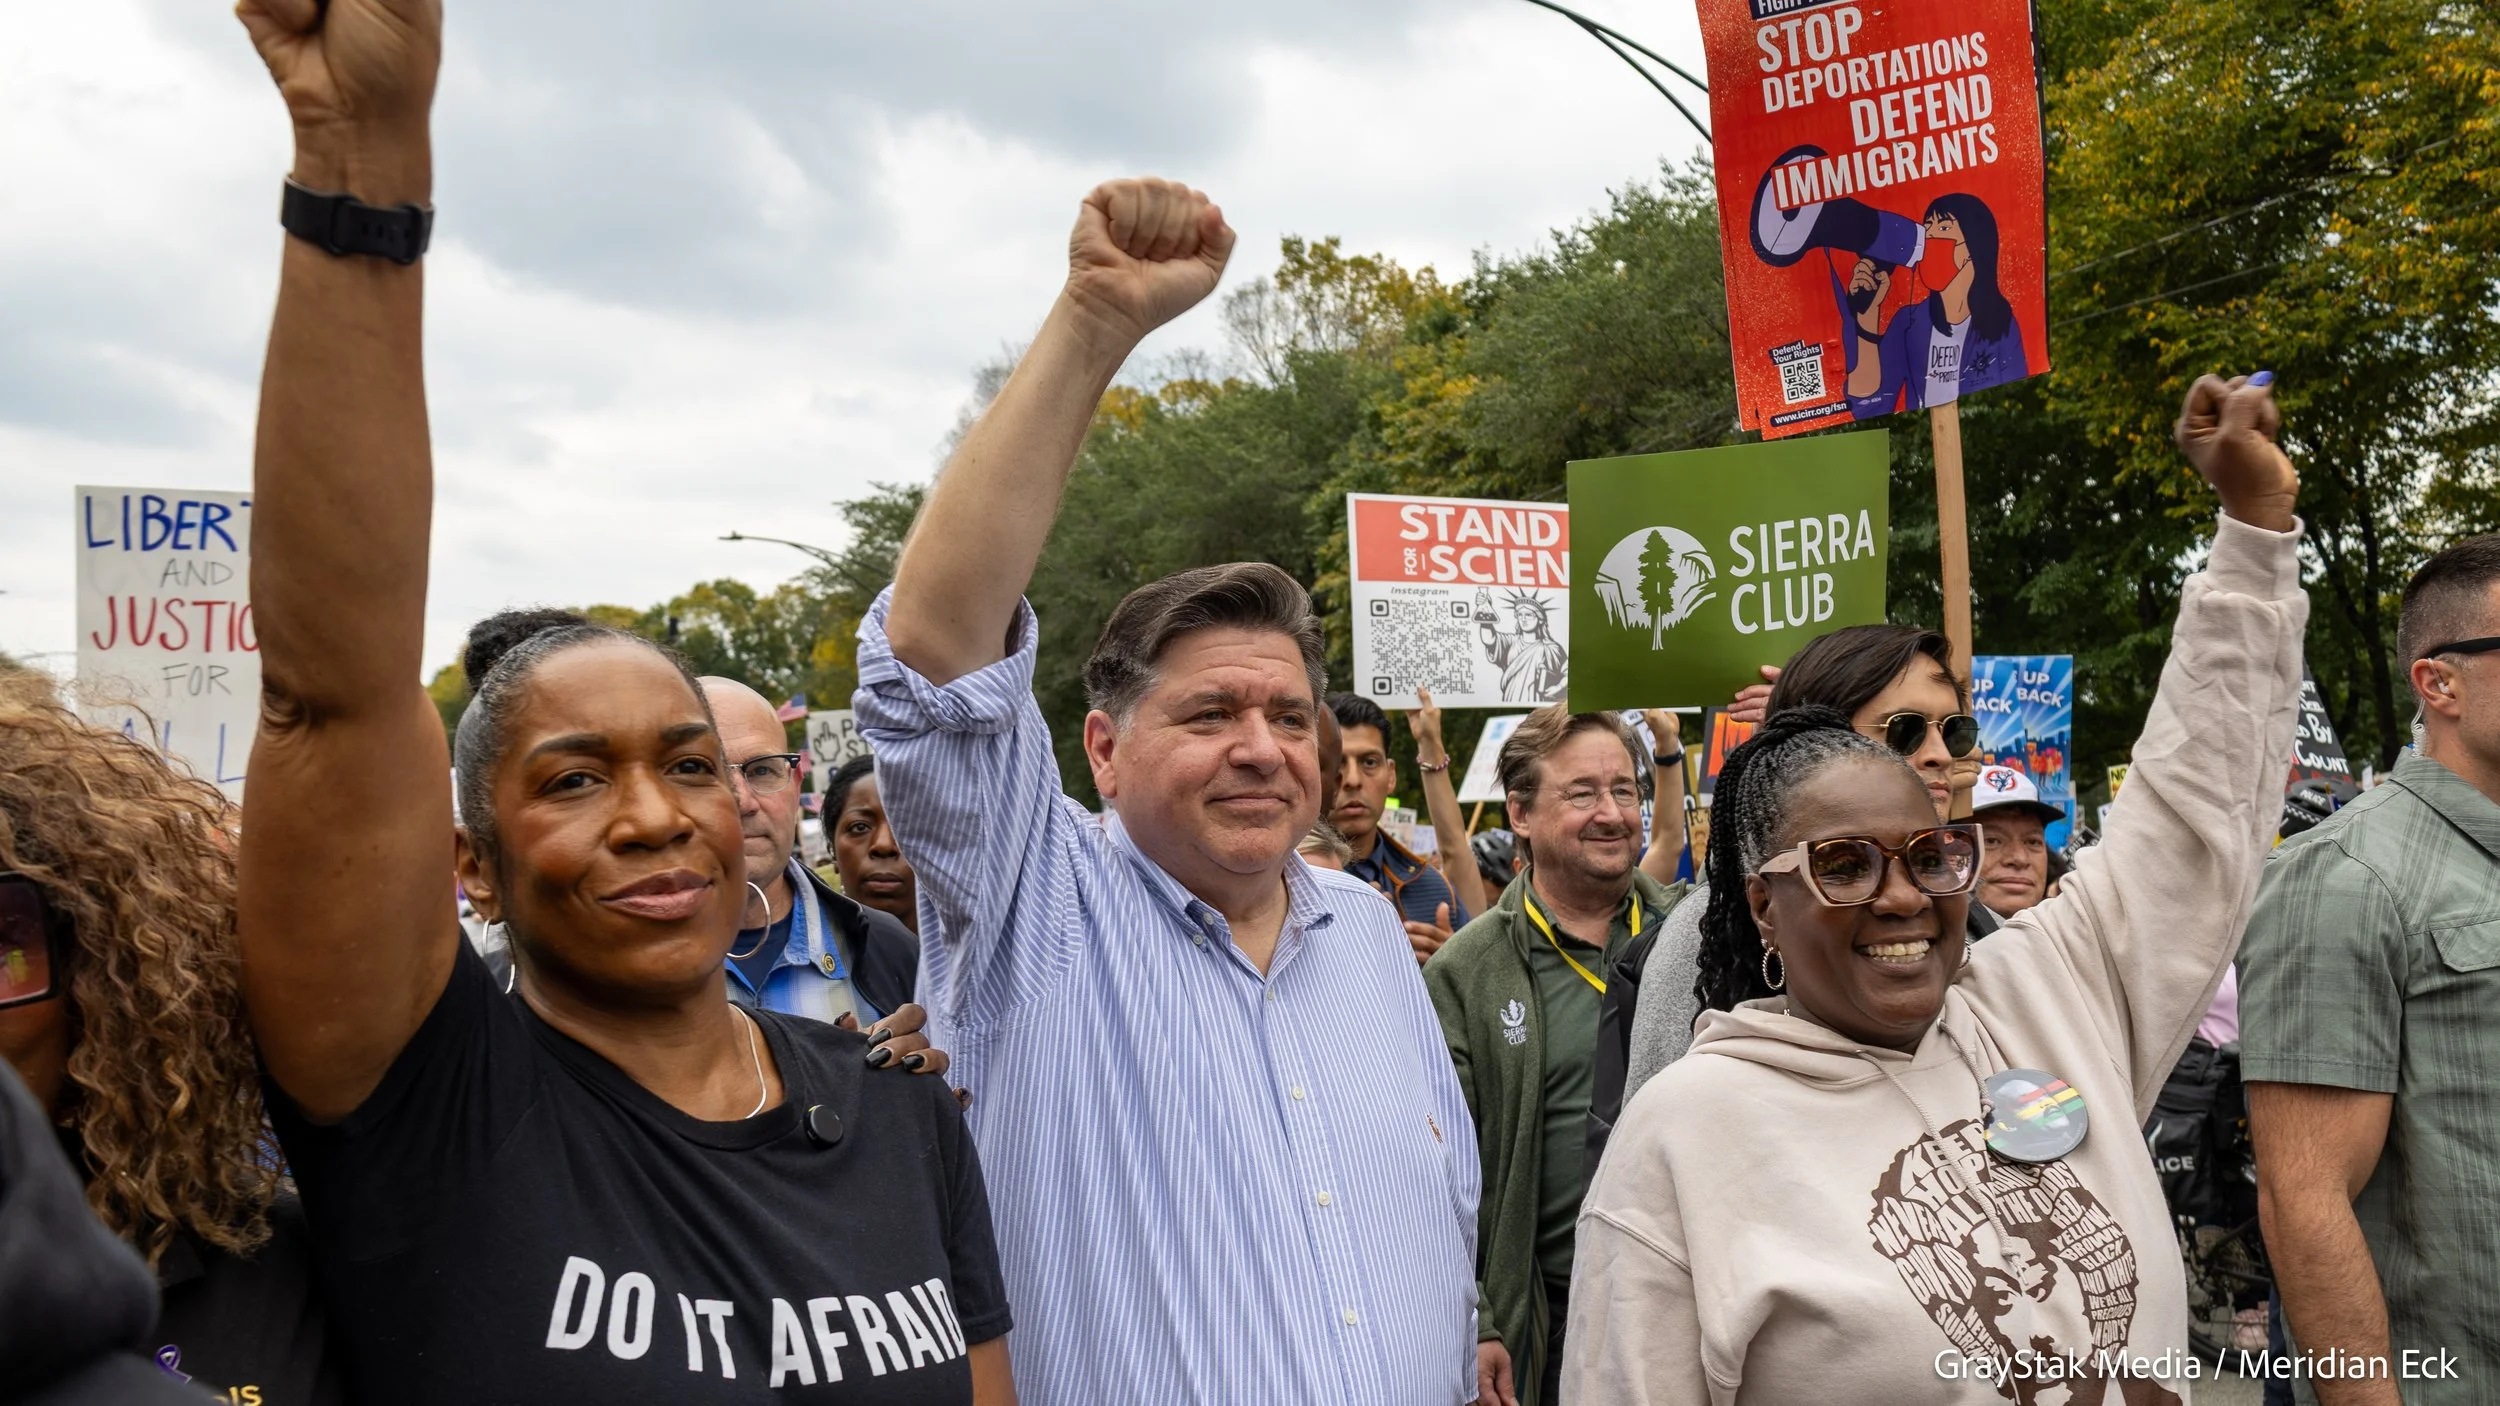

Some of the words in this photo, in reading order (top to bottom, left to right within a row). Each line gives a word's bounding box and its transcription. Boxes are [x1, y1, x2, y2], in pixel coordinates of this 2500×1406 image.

[1757, 6, 1863, 73] STOP
[1762, 31, 1988, 114] DEPORTATIONS
[1849, 73, 1993, 146] DEFEND
[1773, 123, 1999, 210] IMMIGRANTS
[1772, 344, 1802, 356] Defend
[1773, 353, 1793, 364] Your
[1795, 346, 1820, 361] Rights
[1931, 344, 1961, 369] DEFEND
[1775, 402, 1847, 424] www.icirr.org/fsn
[85, 495, 252, 552] LIBER
[1399, 504, 1560, 547] STAND
[1729, 509, 1876, 577] SIERRA
[160, 558, 234, 588] AND
[1404, 547, 1418, 575] FOR
[1429, 545, 1569, 586] SCIEN
[1391, 586, 1449, 596] Instagram
[1731, 572, 1835, 634] CLUB
[92, 596, 259, 653] JUSTIC
[161, 662, 233, 697] FOR
[2023, 670, 2050, 686] UP
[1972, 697, 2014, 714] ACK
[2017, 687, 2065, 709] BACK
[1900, 1122, 1986, 1197] KEEP
[2155, 1155, 2195, 1173] ICE
[1904, 1150, 1998, 1212] HOPE
[1869, 1196, 1950, 1257] NEVER
[1998, 1190, 2042, 1226] THE
[2079, 1238, 2124, 1271] BLACK
[1896, 1244, 1965, 1306] GIVE
[1933, 1242, 1977, 1300] UP
[2079, 1270, 2106, 1295] AND
[2091, 1302, 2135, 1320] PRECIOUS
[2116, 1286, 2134, 1303] ALL
[545, 1256, 655, 1360] DO
[677, 1292, 737, 1379] IT
[769, 1277, 968, 1388] AFRAID
[1963, 1305, 2001, 1359] NEVER
